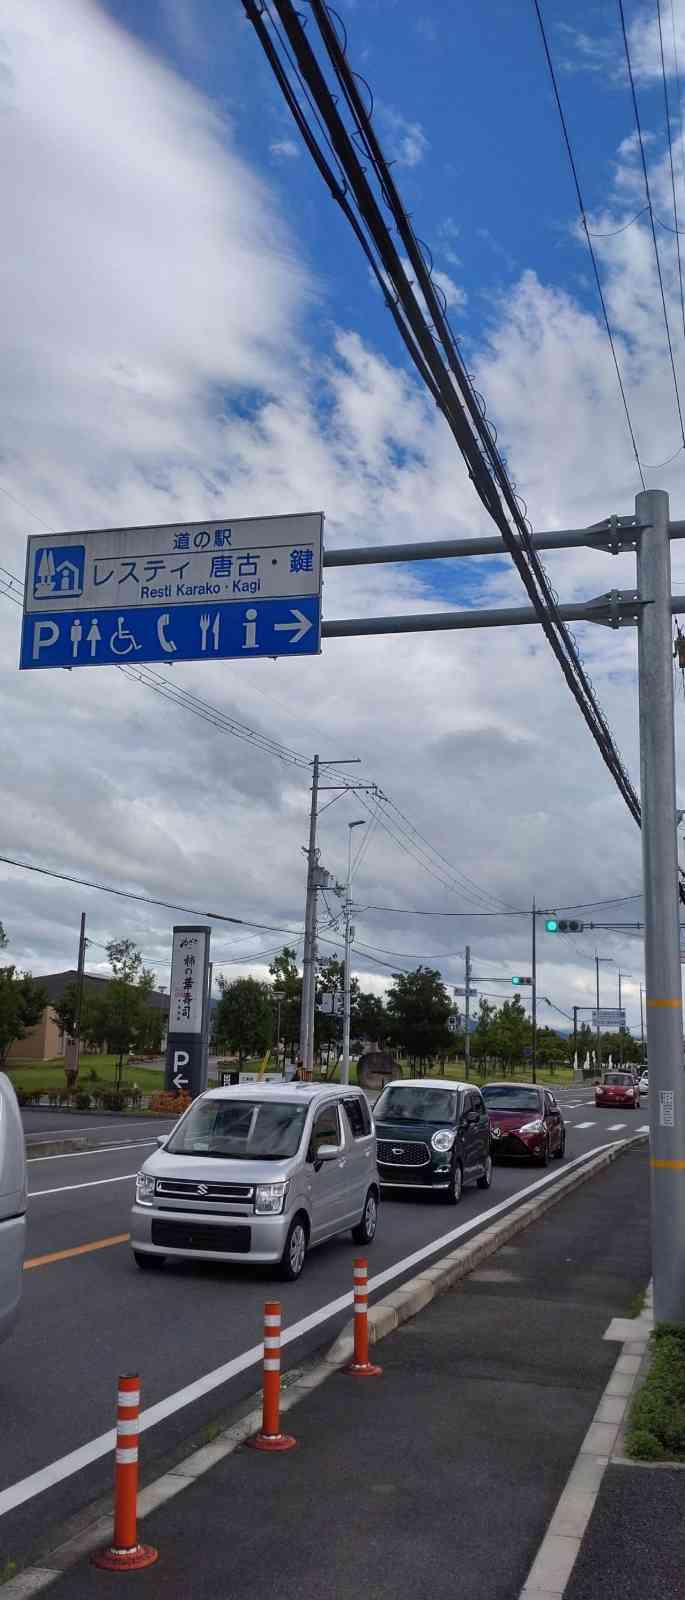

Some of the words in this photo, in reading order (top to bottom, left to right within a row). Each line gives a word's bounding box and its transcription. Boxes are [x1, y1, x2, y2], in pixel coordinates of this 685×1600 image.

[172, 528, 232, 551] 道の駅
[93, 559, 190, 586] レスティ
[209, 549, 314, 578] 唐古・鍵
[140, 584, 172, 599] Resti
[32, 620, 60, 660] P
[173, 1050, 189, 1072] P
